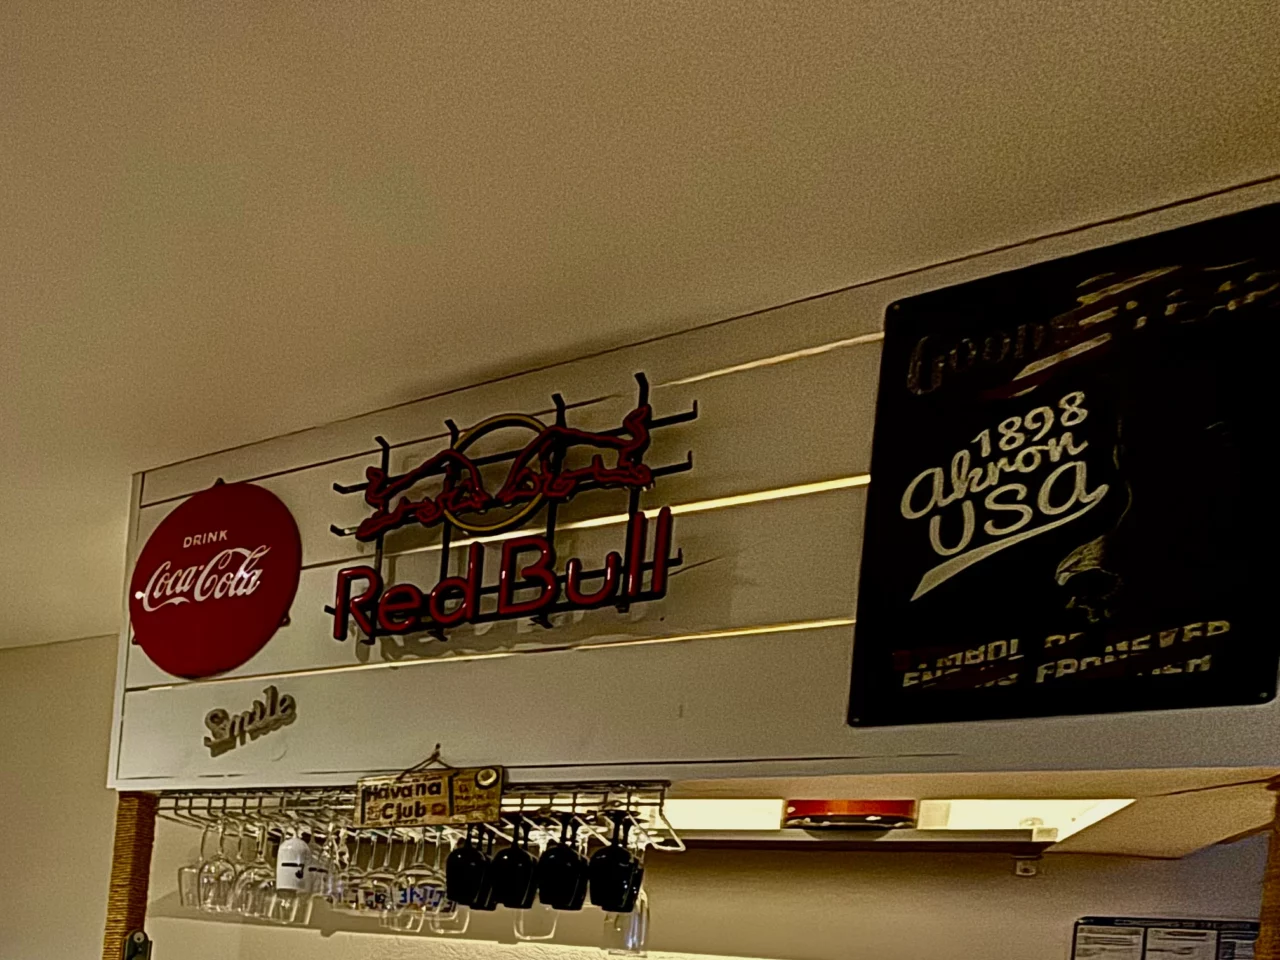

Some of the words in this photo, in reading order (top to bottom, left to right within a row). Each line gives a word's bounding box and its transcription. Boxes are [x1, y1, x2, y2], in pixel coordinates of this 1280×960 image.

[971, 390, 1089, 458] 1898
[900, 430, 1089, 520] Akron
[928, 460, 1110, 556] USA
[183, 529, 228, 549] DRINK
[333, 541, 484, 641] Red
[497, 505, 672, 615] Bull
[142, 544, 272, 613] Coca-Cola
[365, 781, 442, 801] Havana
[381, 801, 427, 819] Club
